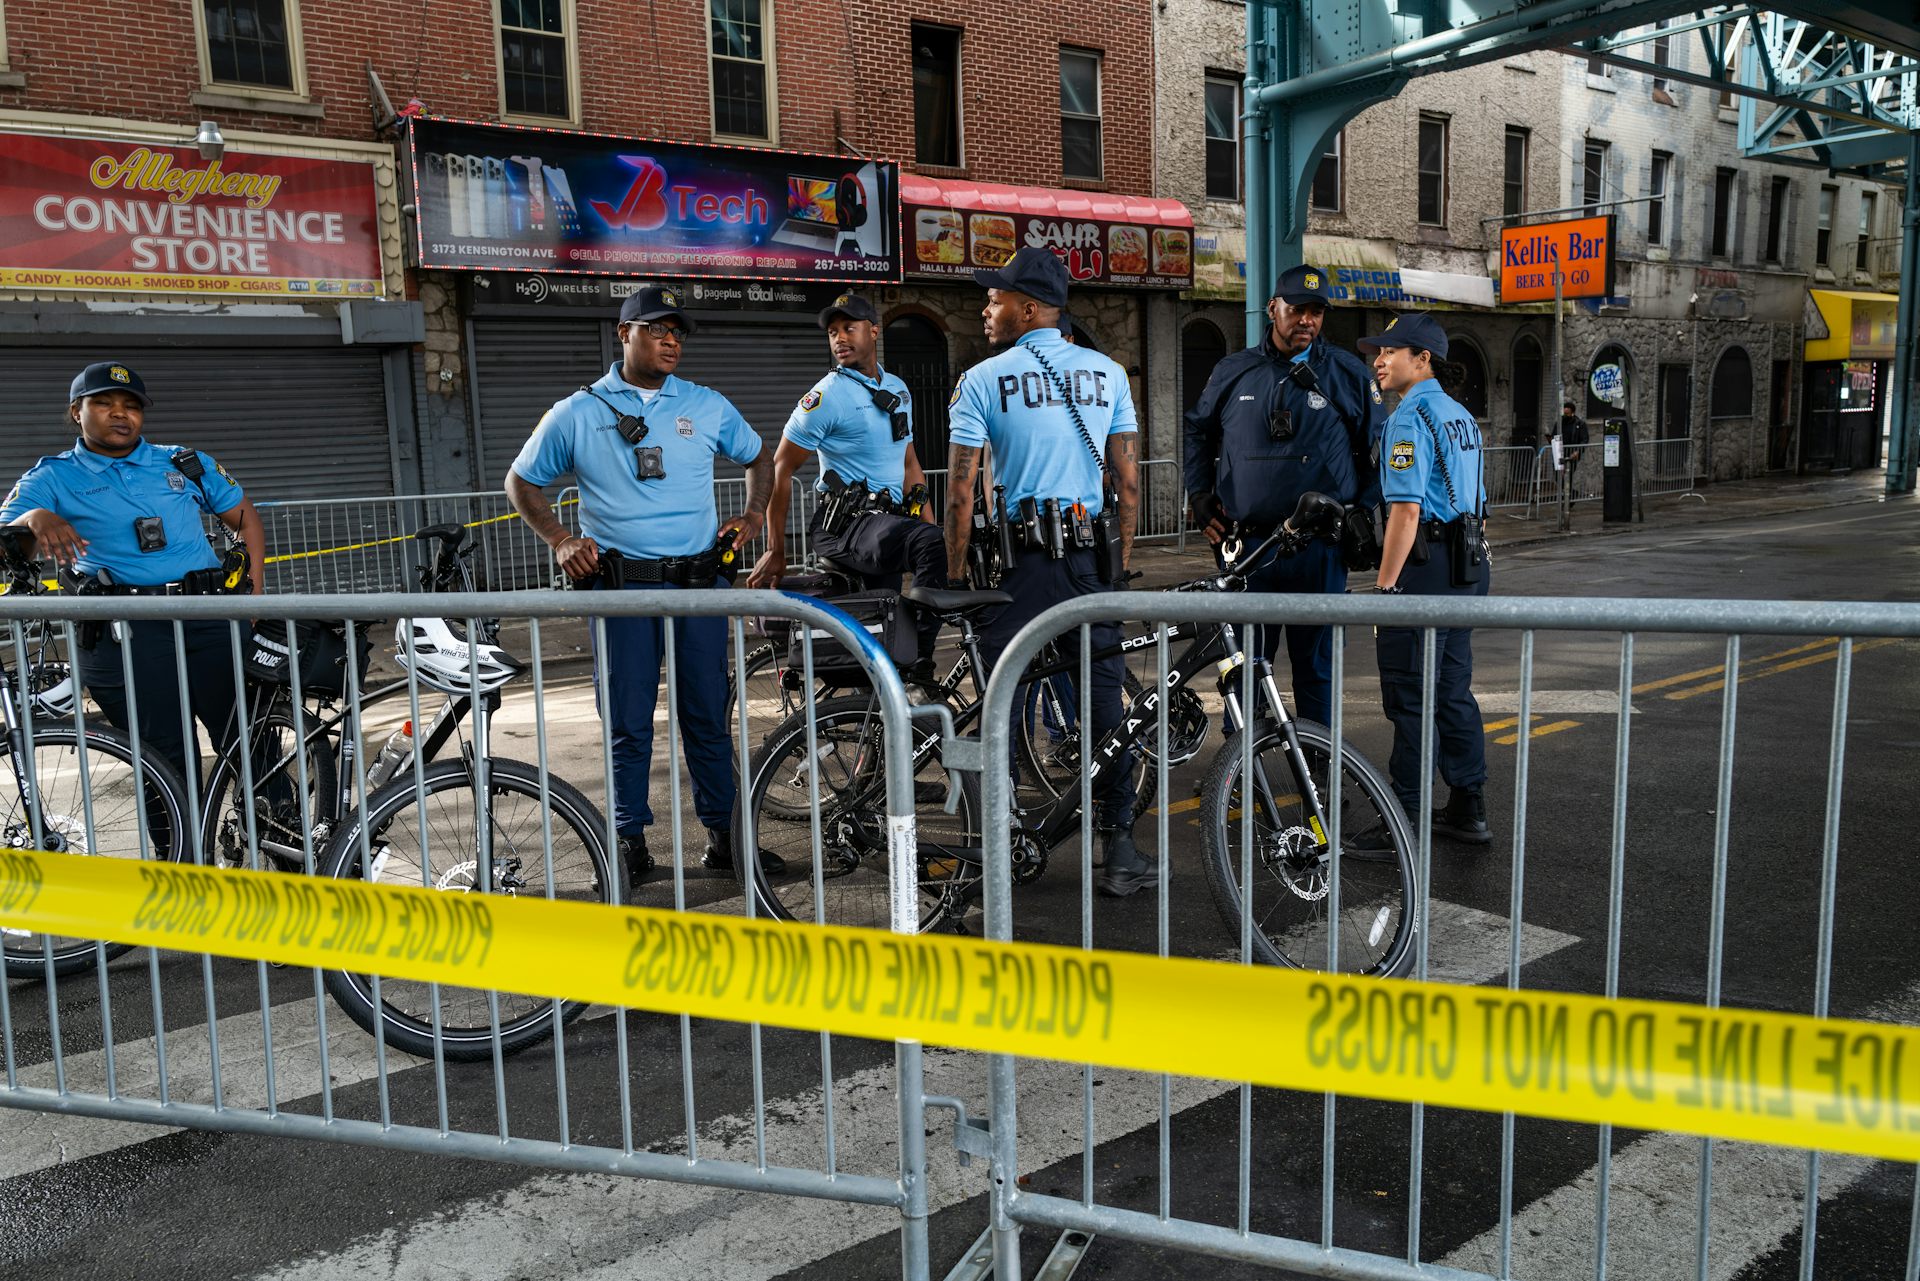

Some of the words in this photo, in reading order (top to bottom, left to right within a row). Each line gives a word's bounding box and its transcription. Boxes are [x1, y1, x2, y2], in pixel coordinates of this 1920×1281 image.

[90, 147, 281, 208] Allegheny
[672, 185, 769, 226] Tech
[34, 194, 345, 244] CONVENIENCE
[1024, 219, 1100, 249] SAHR
[131, 236, 271, 273] STORE
[432, 244, 456, 254] 3173
[458, 245, 530, 258] KENSINGTON
[532, 247, 557, 259] AVE.
[570, 249, 600, 261] CELL
[604, 250, 647, 263] PHONE
[650, 252, 677, 264] AND
[680, 253, 753, 267] ELECTRONIC
[756, 256, 797, 269] REPAIR
[1505, 235, 1558, 268] Kellis
[1568, 232, 1604, 261] Bar
[814, 258, 890, 271] 267-951-3020
[920, 263, 945, 273] HALAL
[15, 272, 61, 285] CANDY
[74, 274, 131, 287] HOOKAH
[143, 277, 195, 289] SMOKED
[198, 279, 230, 290] SHOP
[240, 280, 282, 291] CIGARS
[289, 281, 309, 290] ATM
[1110, 275, 1140, 284] BREAKFAST
[1146, 276, 1164, 285] LUNCH
[1170, 278, 1190, 286] DINNER
[1336, 268, 1401, 286] SPECIA
[1516, 273, 1545, 289] BEER
[1550, 271, 1566, 287] TO
[1571, 269, 1590, 285] GO
[550, 284, 600, 294] WIRELESS
[703, 289, 742, 301] pageplus
[747, 287, 774, 302] total
[774, 292, 806, 302] Wireless
[1852, 372, 1873, 390] OPEN
[998, 370, 1108, 412] POLICE
[1393, 446, 1413, 456] POLICE
[253, 649, 281, 667] POLICE
[423, 663, 463, 680] BONTRAGER
